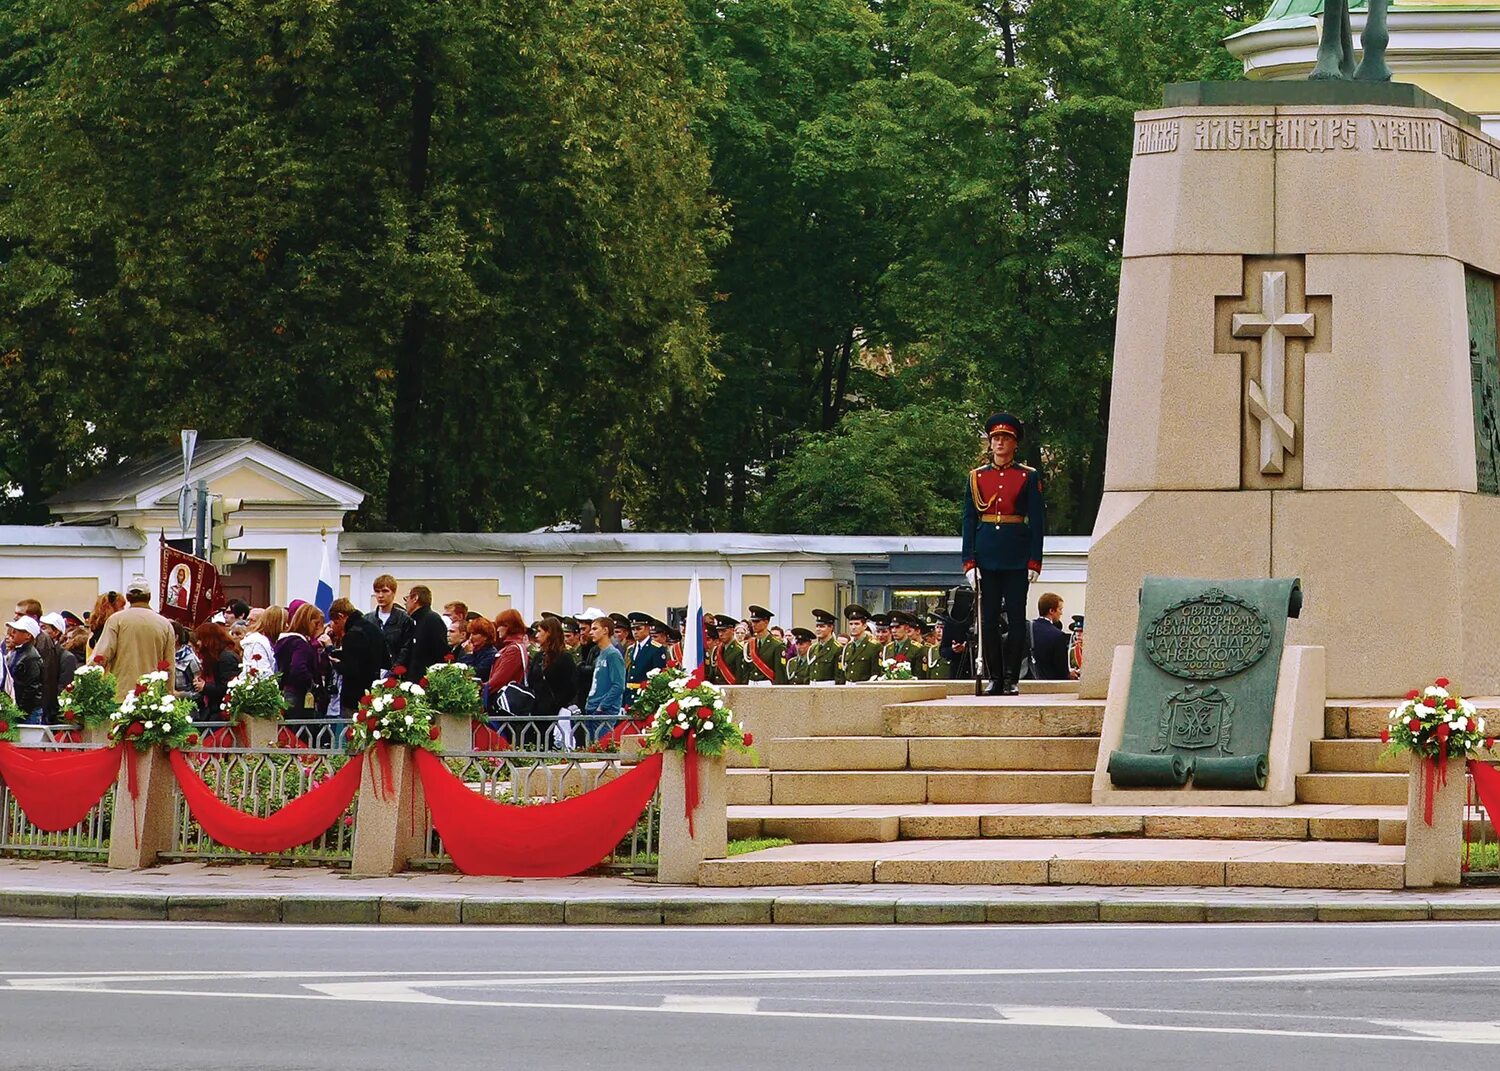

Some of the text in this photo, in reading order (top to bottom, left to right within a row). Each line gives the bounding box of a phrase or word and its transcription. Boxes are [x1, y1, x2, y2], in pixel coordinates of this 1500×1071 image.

[1181, 606, 1239, 616] СВЯТОМУ
[1163, 616, 1257, 626] БЛАГОВЕРНОМУ
[1155, 625, 1263, 636] ВЕЛИКОМУ КНЯЗЮ
[1157, 636, 1260, 648] АЛЕКСАНДРУ
[1164, 648, 1251, 661] НЕВСКОМУ
